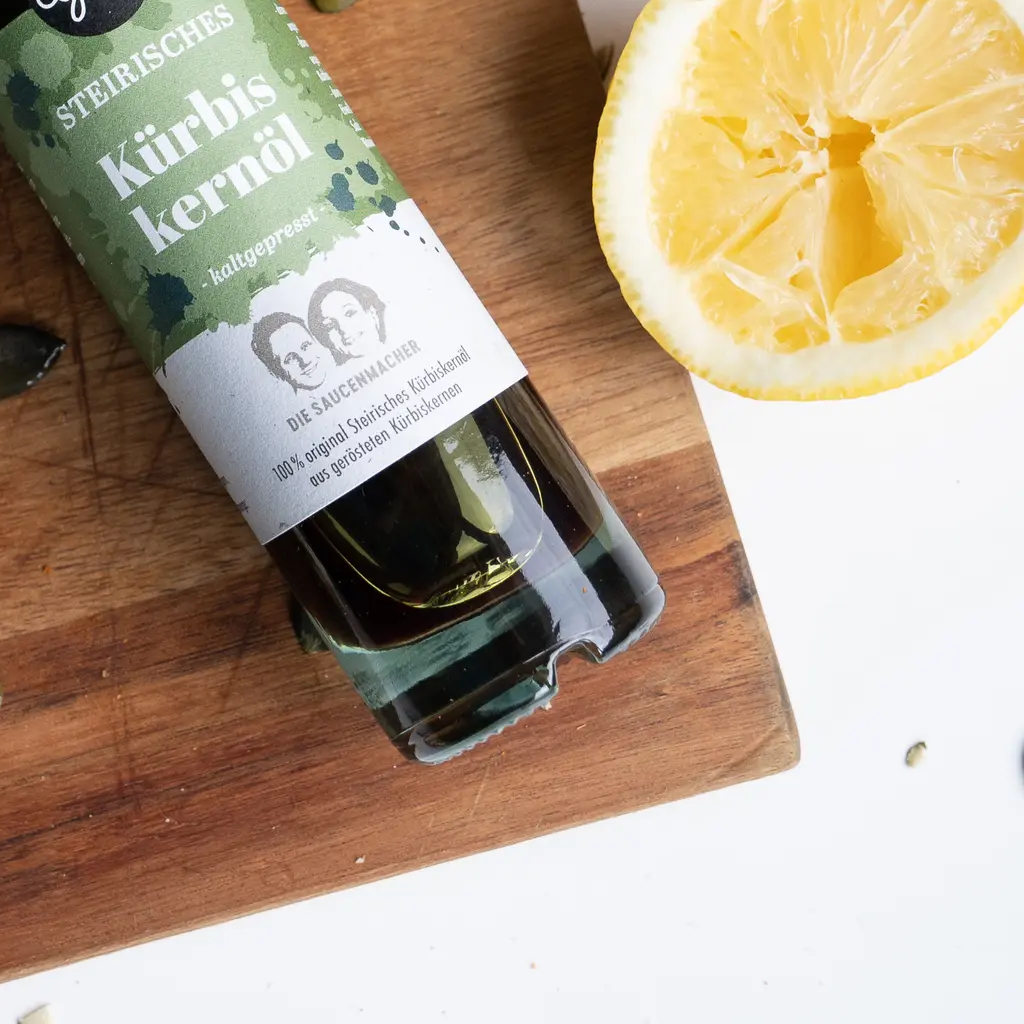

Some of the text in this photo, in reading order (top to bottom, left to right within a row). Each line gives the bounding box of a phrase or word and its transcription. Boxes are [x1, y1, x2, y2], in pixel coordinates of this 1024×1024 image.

[55, 4, 235, 131] STEIRISCHES
[95, 73, 278, 202] Kürbis
[128, 112, 314, 256] kernöl
[207, 207, 319, 285] kaltgepresst
[286, 339, 422, 432] DIE SAUCENMACHER
[305, 423, 349, 463] original
[346, 388, 410, 433] Steirisches
[407, 345, 472, 395] Kürbiskernöl
[309, 382, 463, 487] aus gerösteten Kürbiskernen
